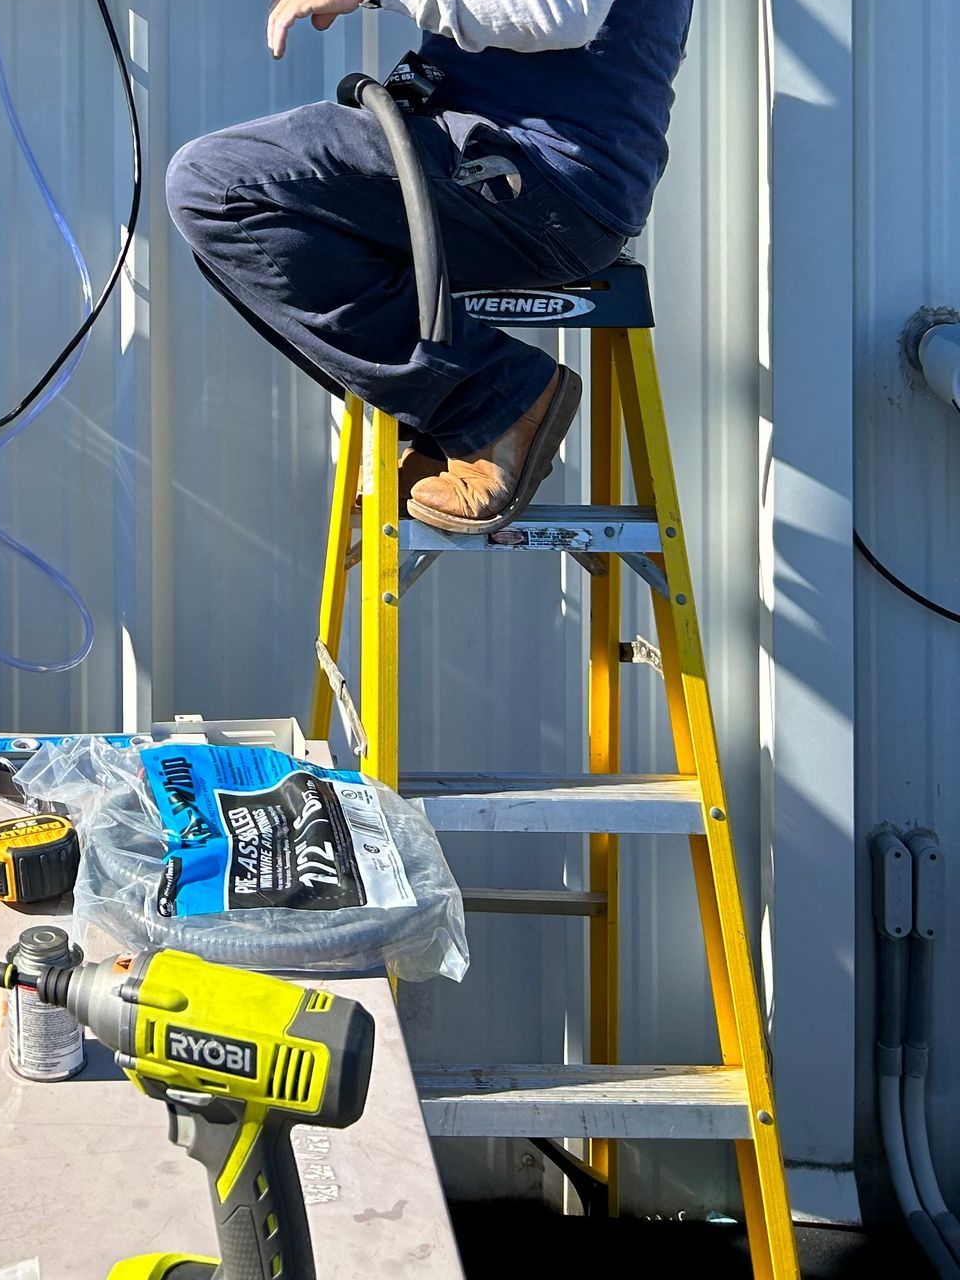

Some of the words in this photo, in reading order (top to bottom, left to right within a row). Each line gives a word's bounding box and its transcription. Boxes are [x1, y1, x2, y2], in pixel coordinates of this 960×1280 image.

[464, 298, 564, 313] WERNER
[260, 849, 273, 874] WIRE
[169, 1032, 251, 1072] RYOBI
